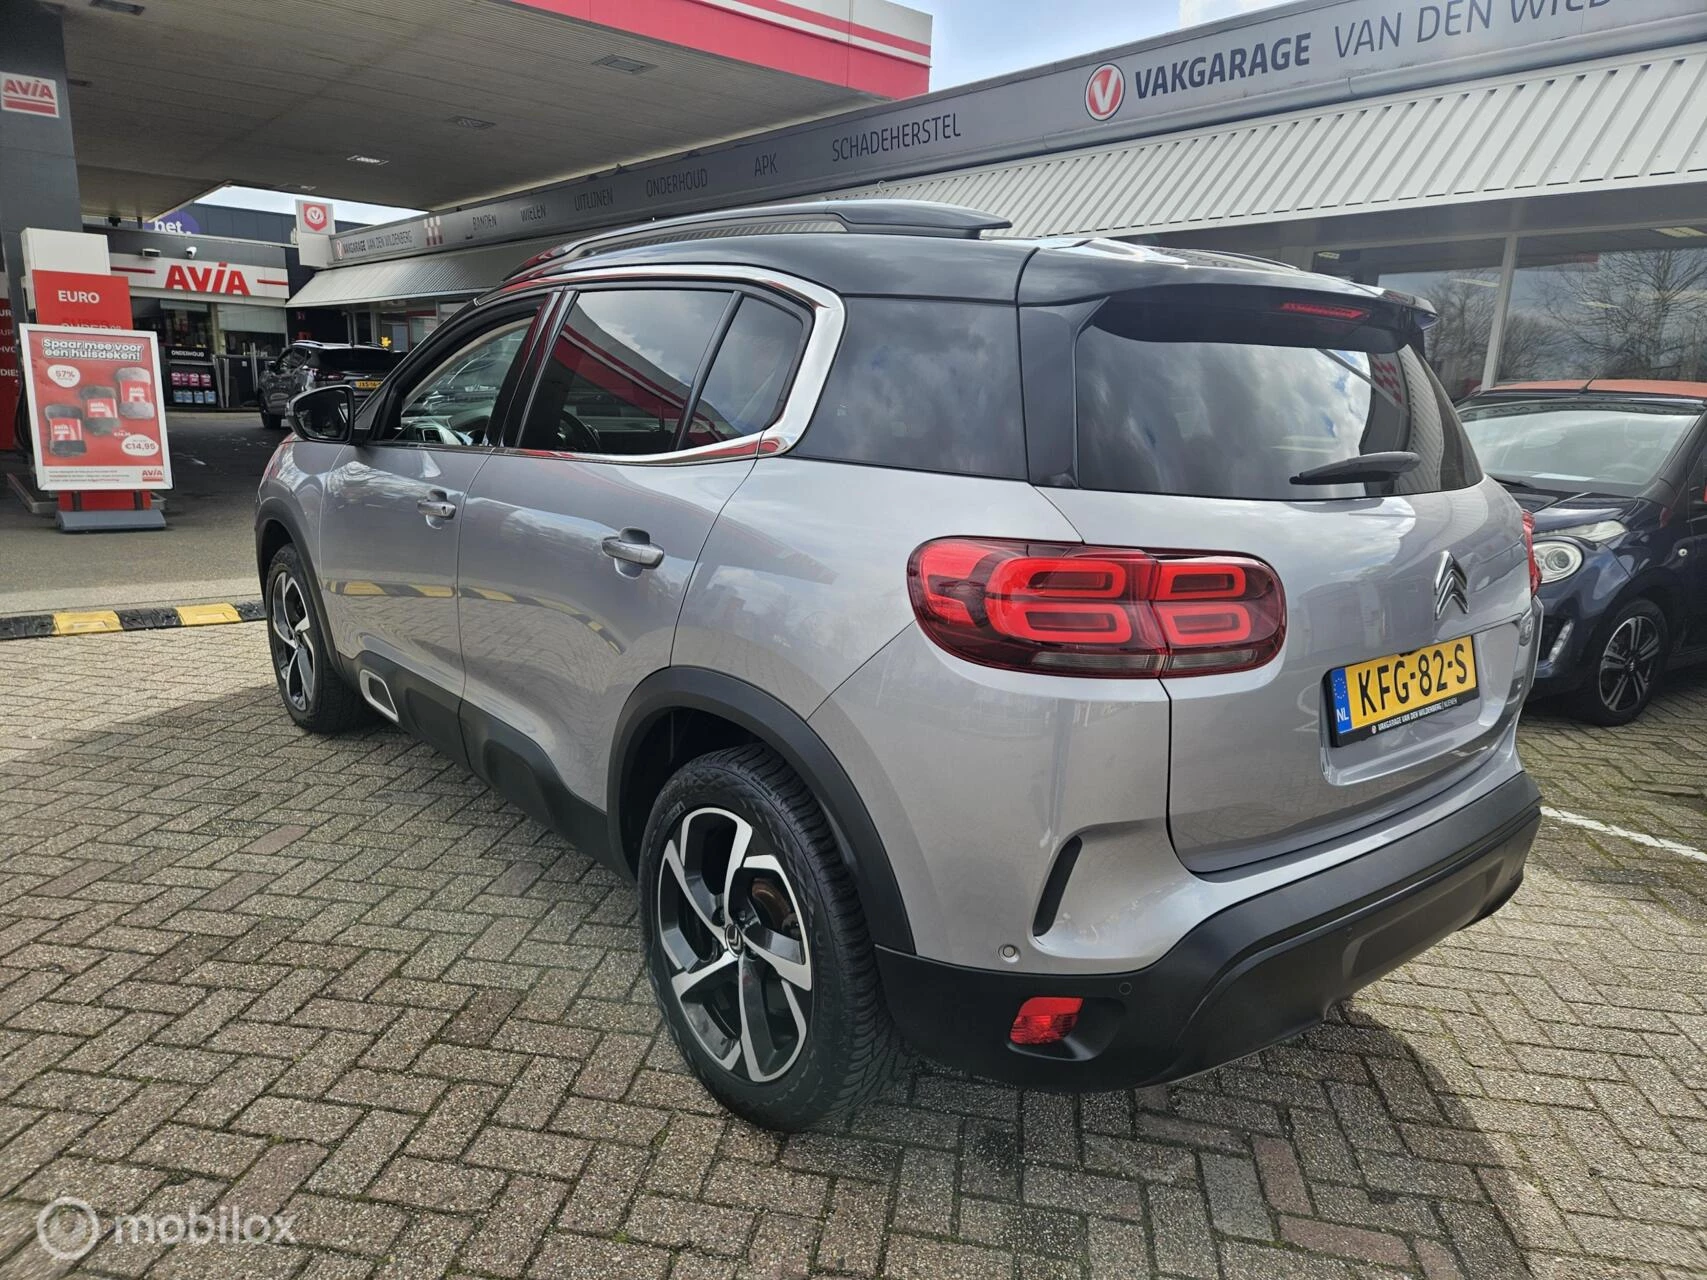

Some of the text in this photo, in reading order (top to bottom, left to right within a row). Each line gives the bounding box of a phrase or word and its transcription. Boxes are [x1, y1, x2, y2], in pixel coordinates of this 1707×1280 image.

[1134, 32, 1312, 99] VAKGARAGE
[1333, 13, 1402, 59] VAN
[1416, 0, 1492, 43] DEN
[3, 78, 55, 100] AVIA
[832, 113, 961, 162] SCHADEHERSTEL
[754, 153, 777, 177] APK
[646, 168, 708, 198] ONDERHOUD
[520, 203, 547, 222] WIELEN
[164, 262, 251, 296] AVIA
[57, 290, 100, 304] EURO
[43, 338, 143, 352] Spaar mee voor
[44, 348, 140, 361] een huisdeken!
[142, 469, 163, 477] AVIA
[1358, 643, 1469, 717] KFG-82-S
[1336, 707, 1350, 723] NL
[1402, 714, 1411, 722] VAN
[1410, 711, 1418, 720] DEN
